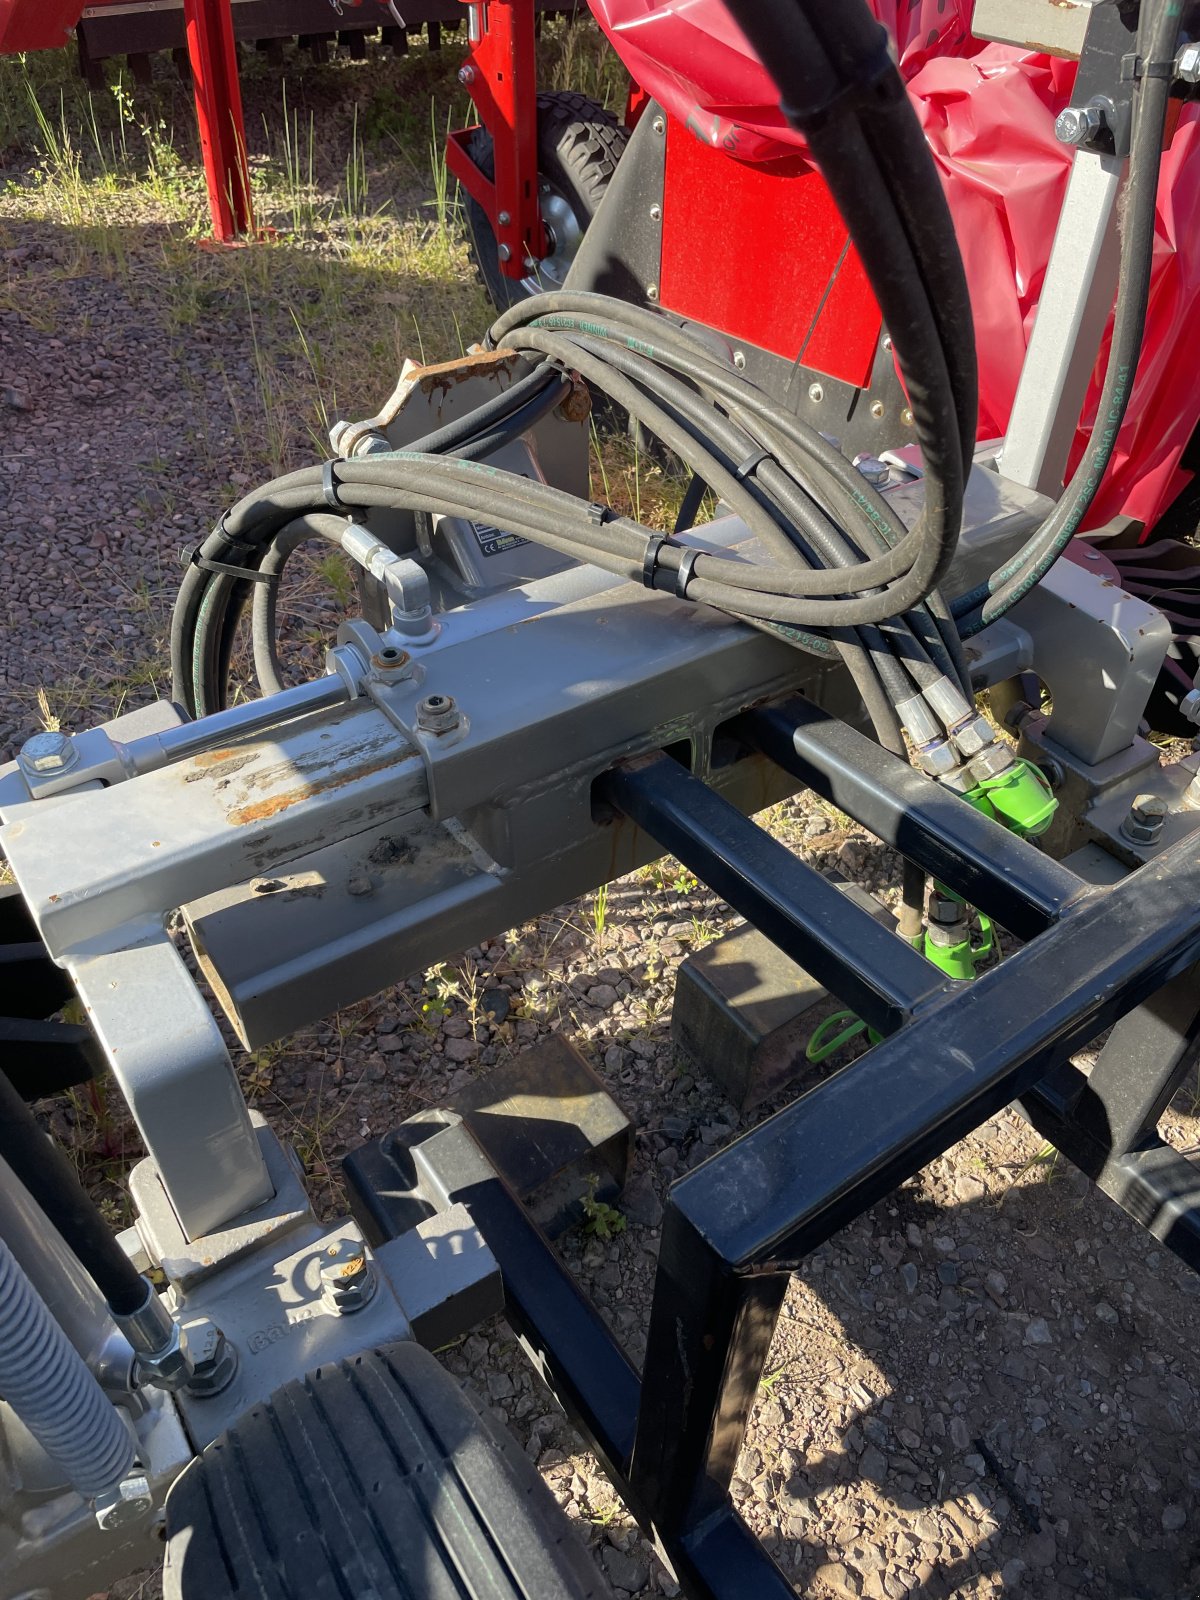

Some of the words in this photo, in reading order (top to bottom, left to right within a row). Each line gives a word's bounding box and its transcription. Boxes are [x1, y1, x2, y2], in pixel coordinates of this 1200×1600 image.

[1055, 507, 1083, 547] EN857
[1079, 478, 1098, 503] 2SC
[1094, 428, 1116, 468] MSHA
